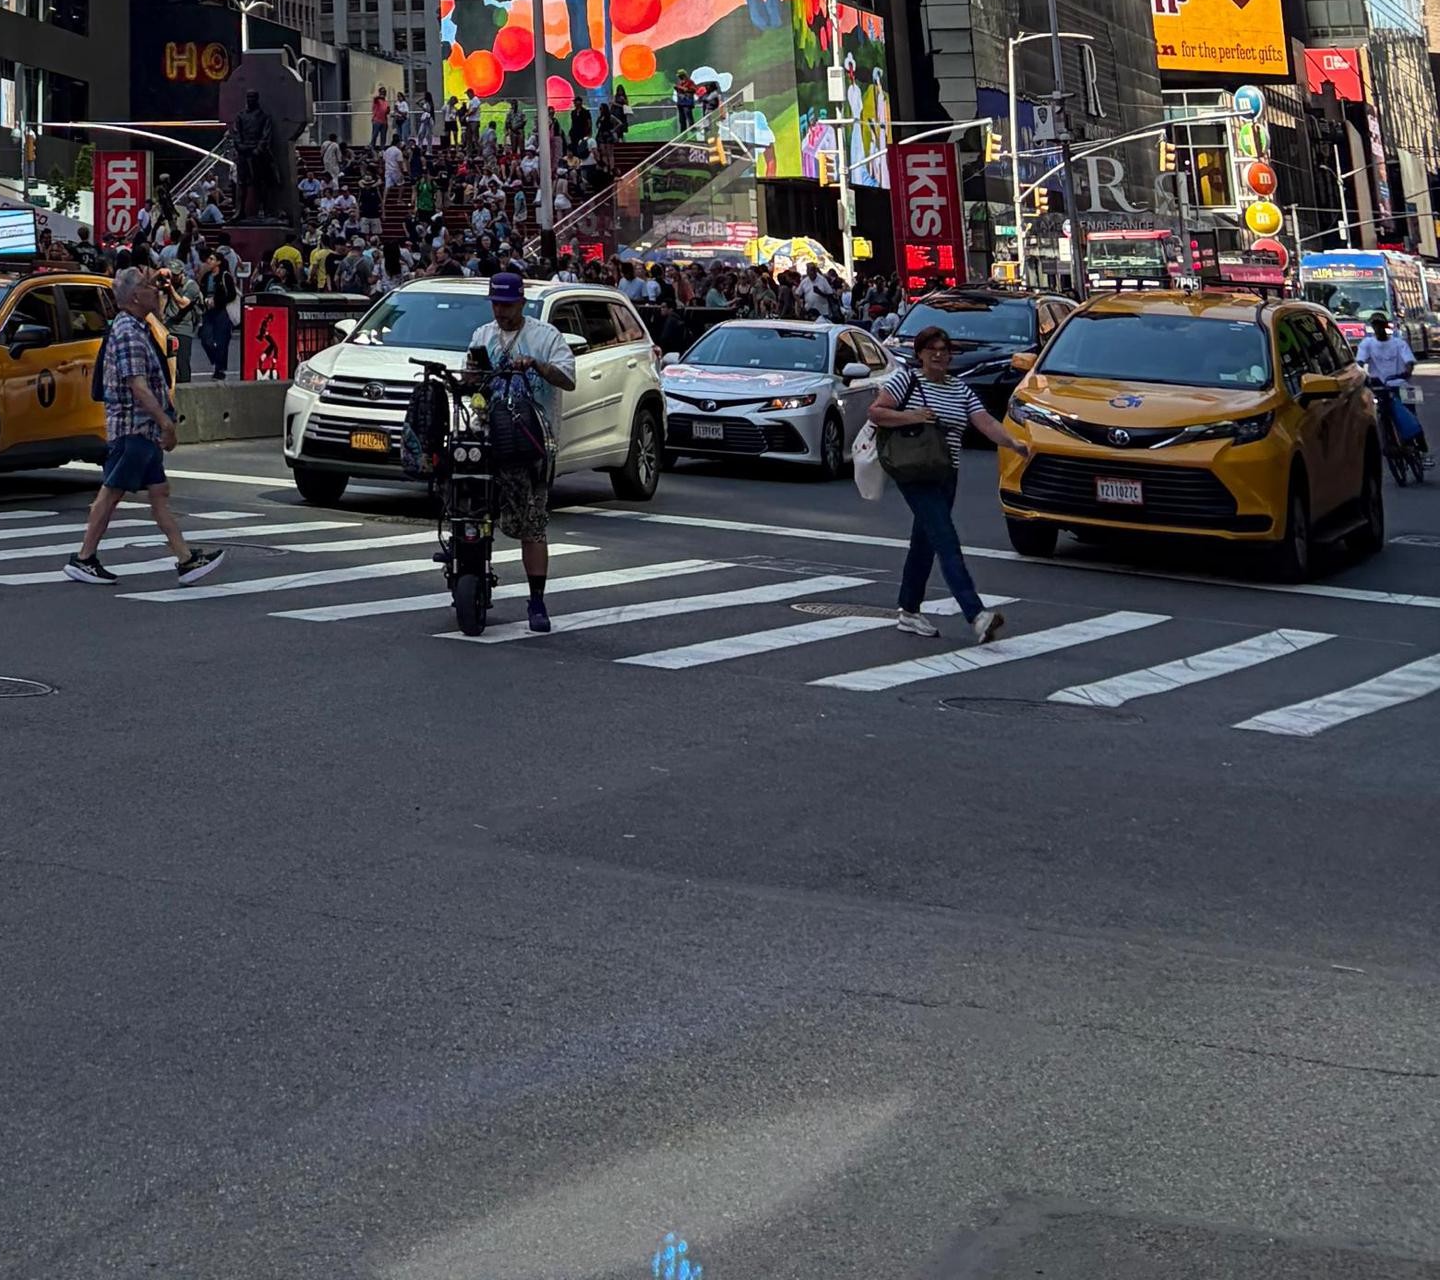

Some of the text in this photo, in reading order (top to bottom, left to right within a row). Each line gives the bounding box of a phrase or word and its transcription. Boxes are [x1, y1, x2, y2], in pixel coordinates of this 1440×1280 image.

[1181, 41, 1284, 65] for the perfect gifts
[107, 157, 137, 233] tkts
[906, 149, 948, 237] tkts
[1085, 155, 1148, 214] R
